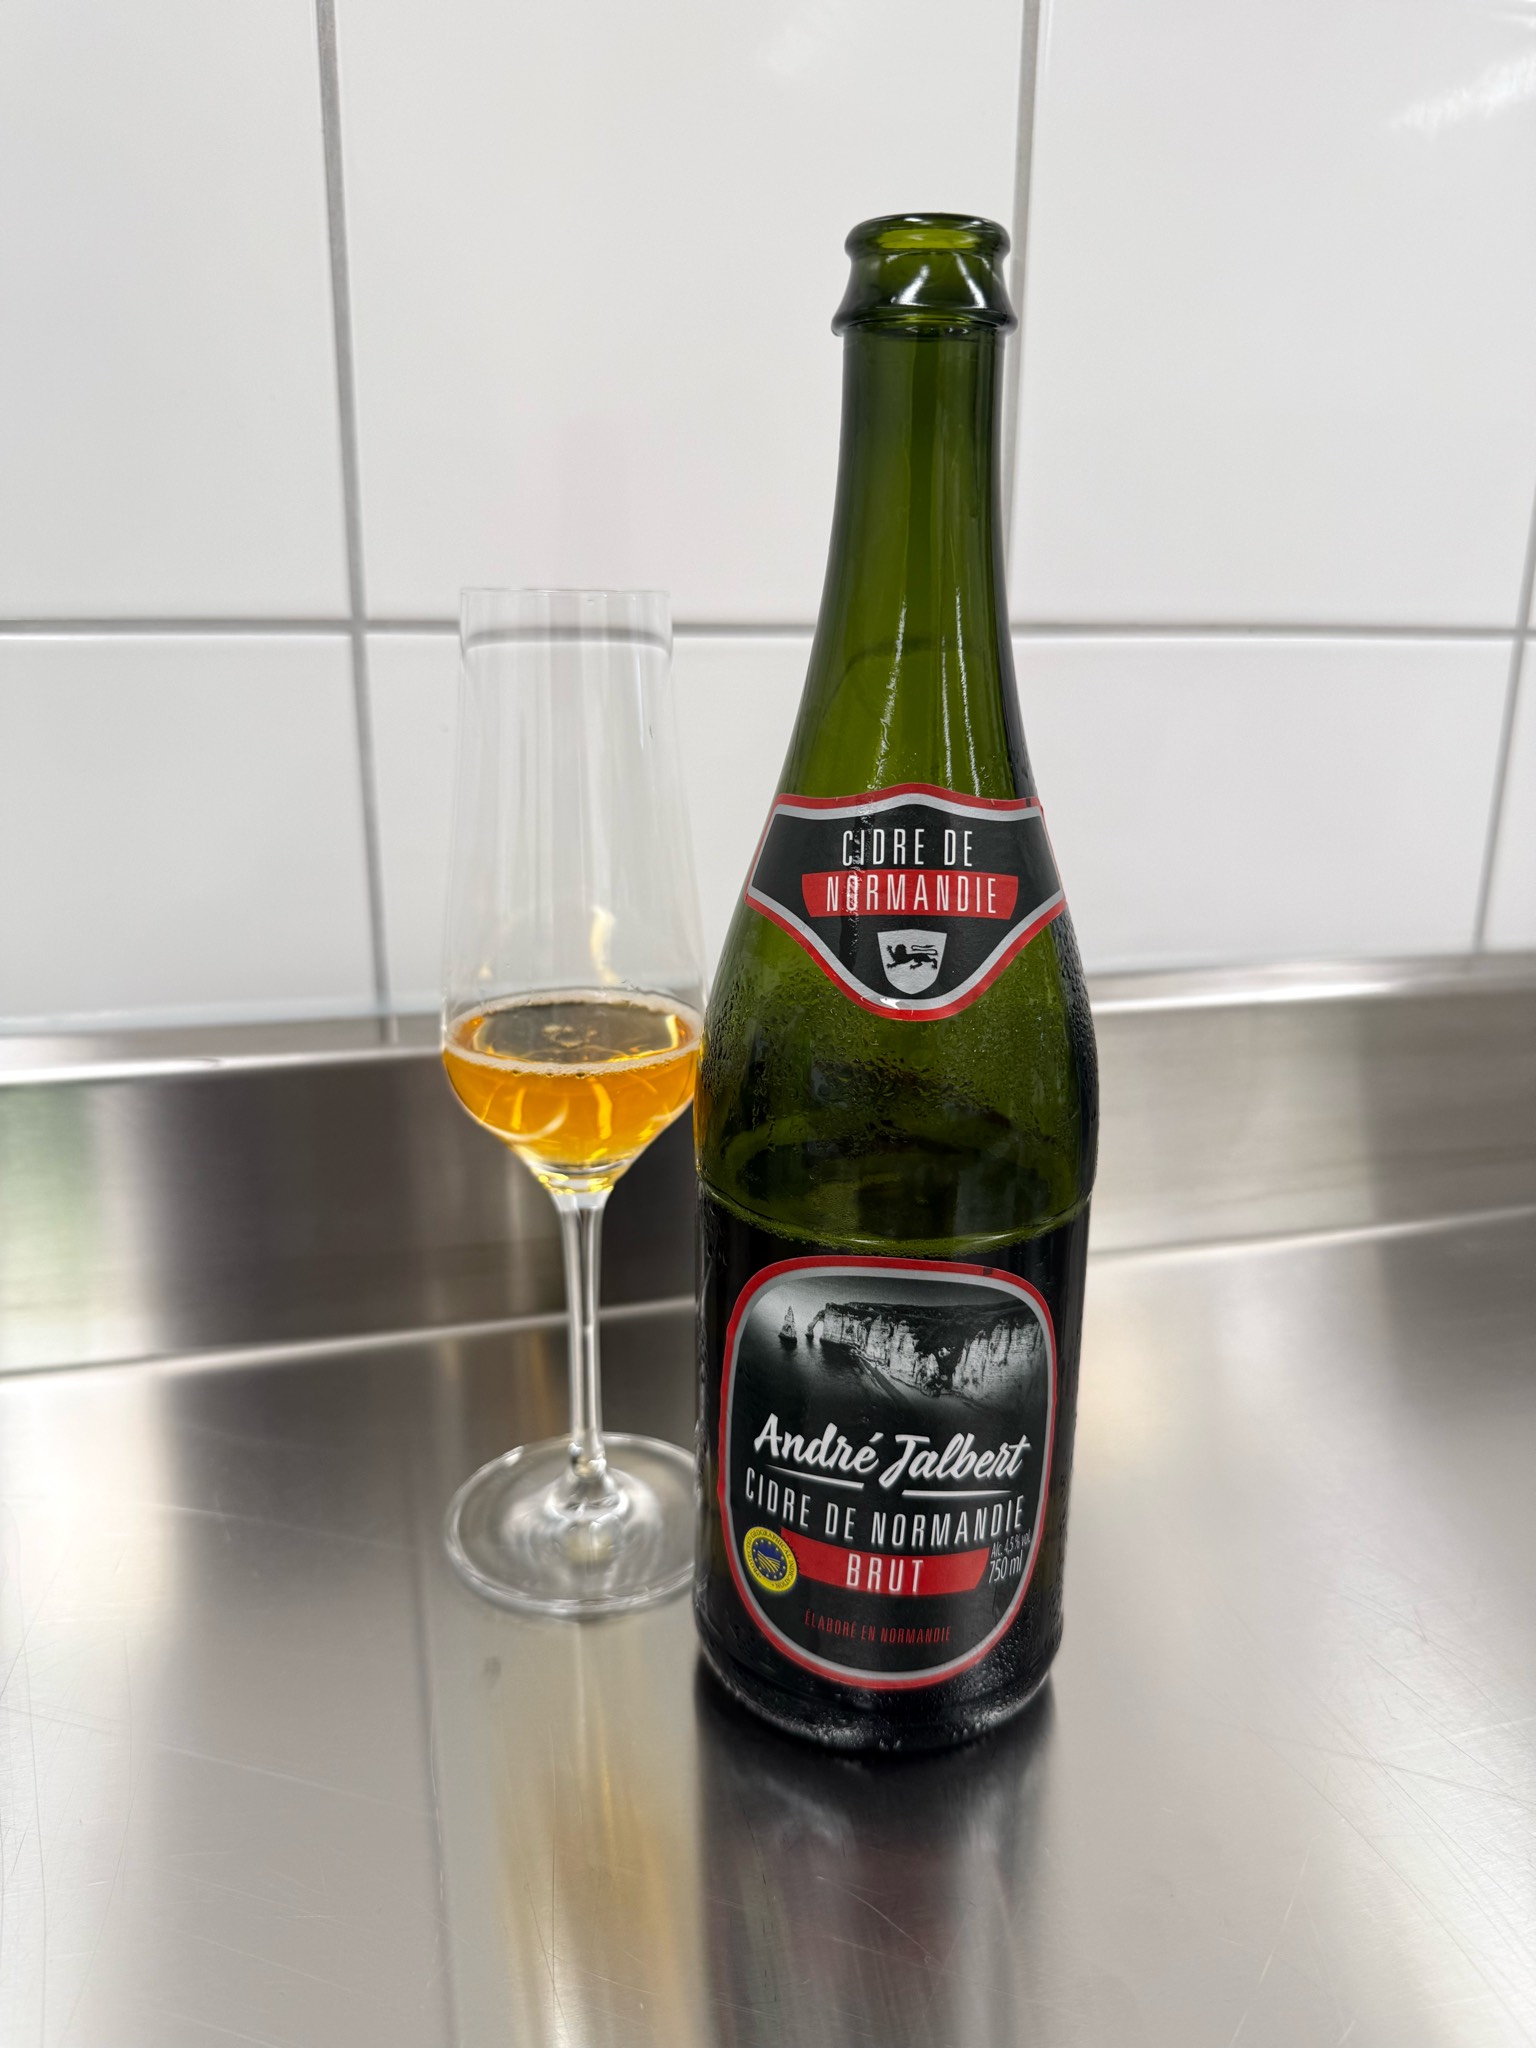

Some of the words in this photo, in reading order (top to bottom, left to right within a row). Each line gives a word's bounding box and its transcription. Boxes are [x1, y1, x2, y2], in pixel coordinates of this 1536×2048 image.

[842, 828, 925, 867] CIDRE
[944, 829, 973, 867] DE
[826, 874, 997, 914] NORMANDIE
[754, 1412, 883, 1474] André
[745, 1466, 811, 1528] CIDRE
[825, 1503, 857, 1541] DE
[872, 1494, 1025, 1547] NORMANDIE
[988, 1555, 1008, 1584] 750
[1009, 1549, 1024, 1577] ml
[991, 1541, 1003, 1558] Alc.
[847, 1553, 925, 1594] BRUT
[804, 1608, 857, 1640] ÉLABORÉ
[861, 1624, 876, 1642] EN
[880, 1625, 952, 1645] NORMANDIE
